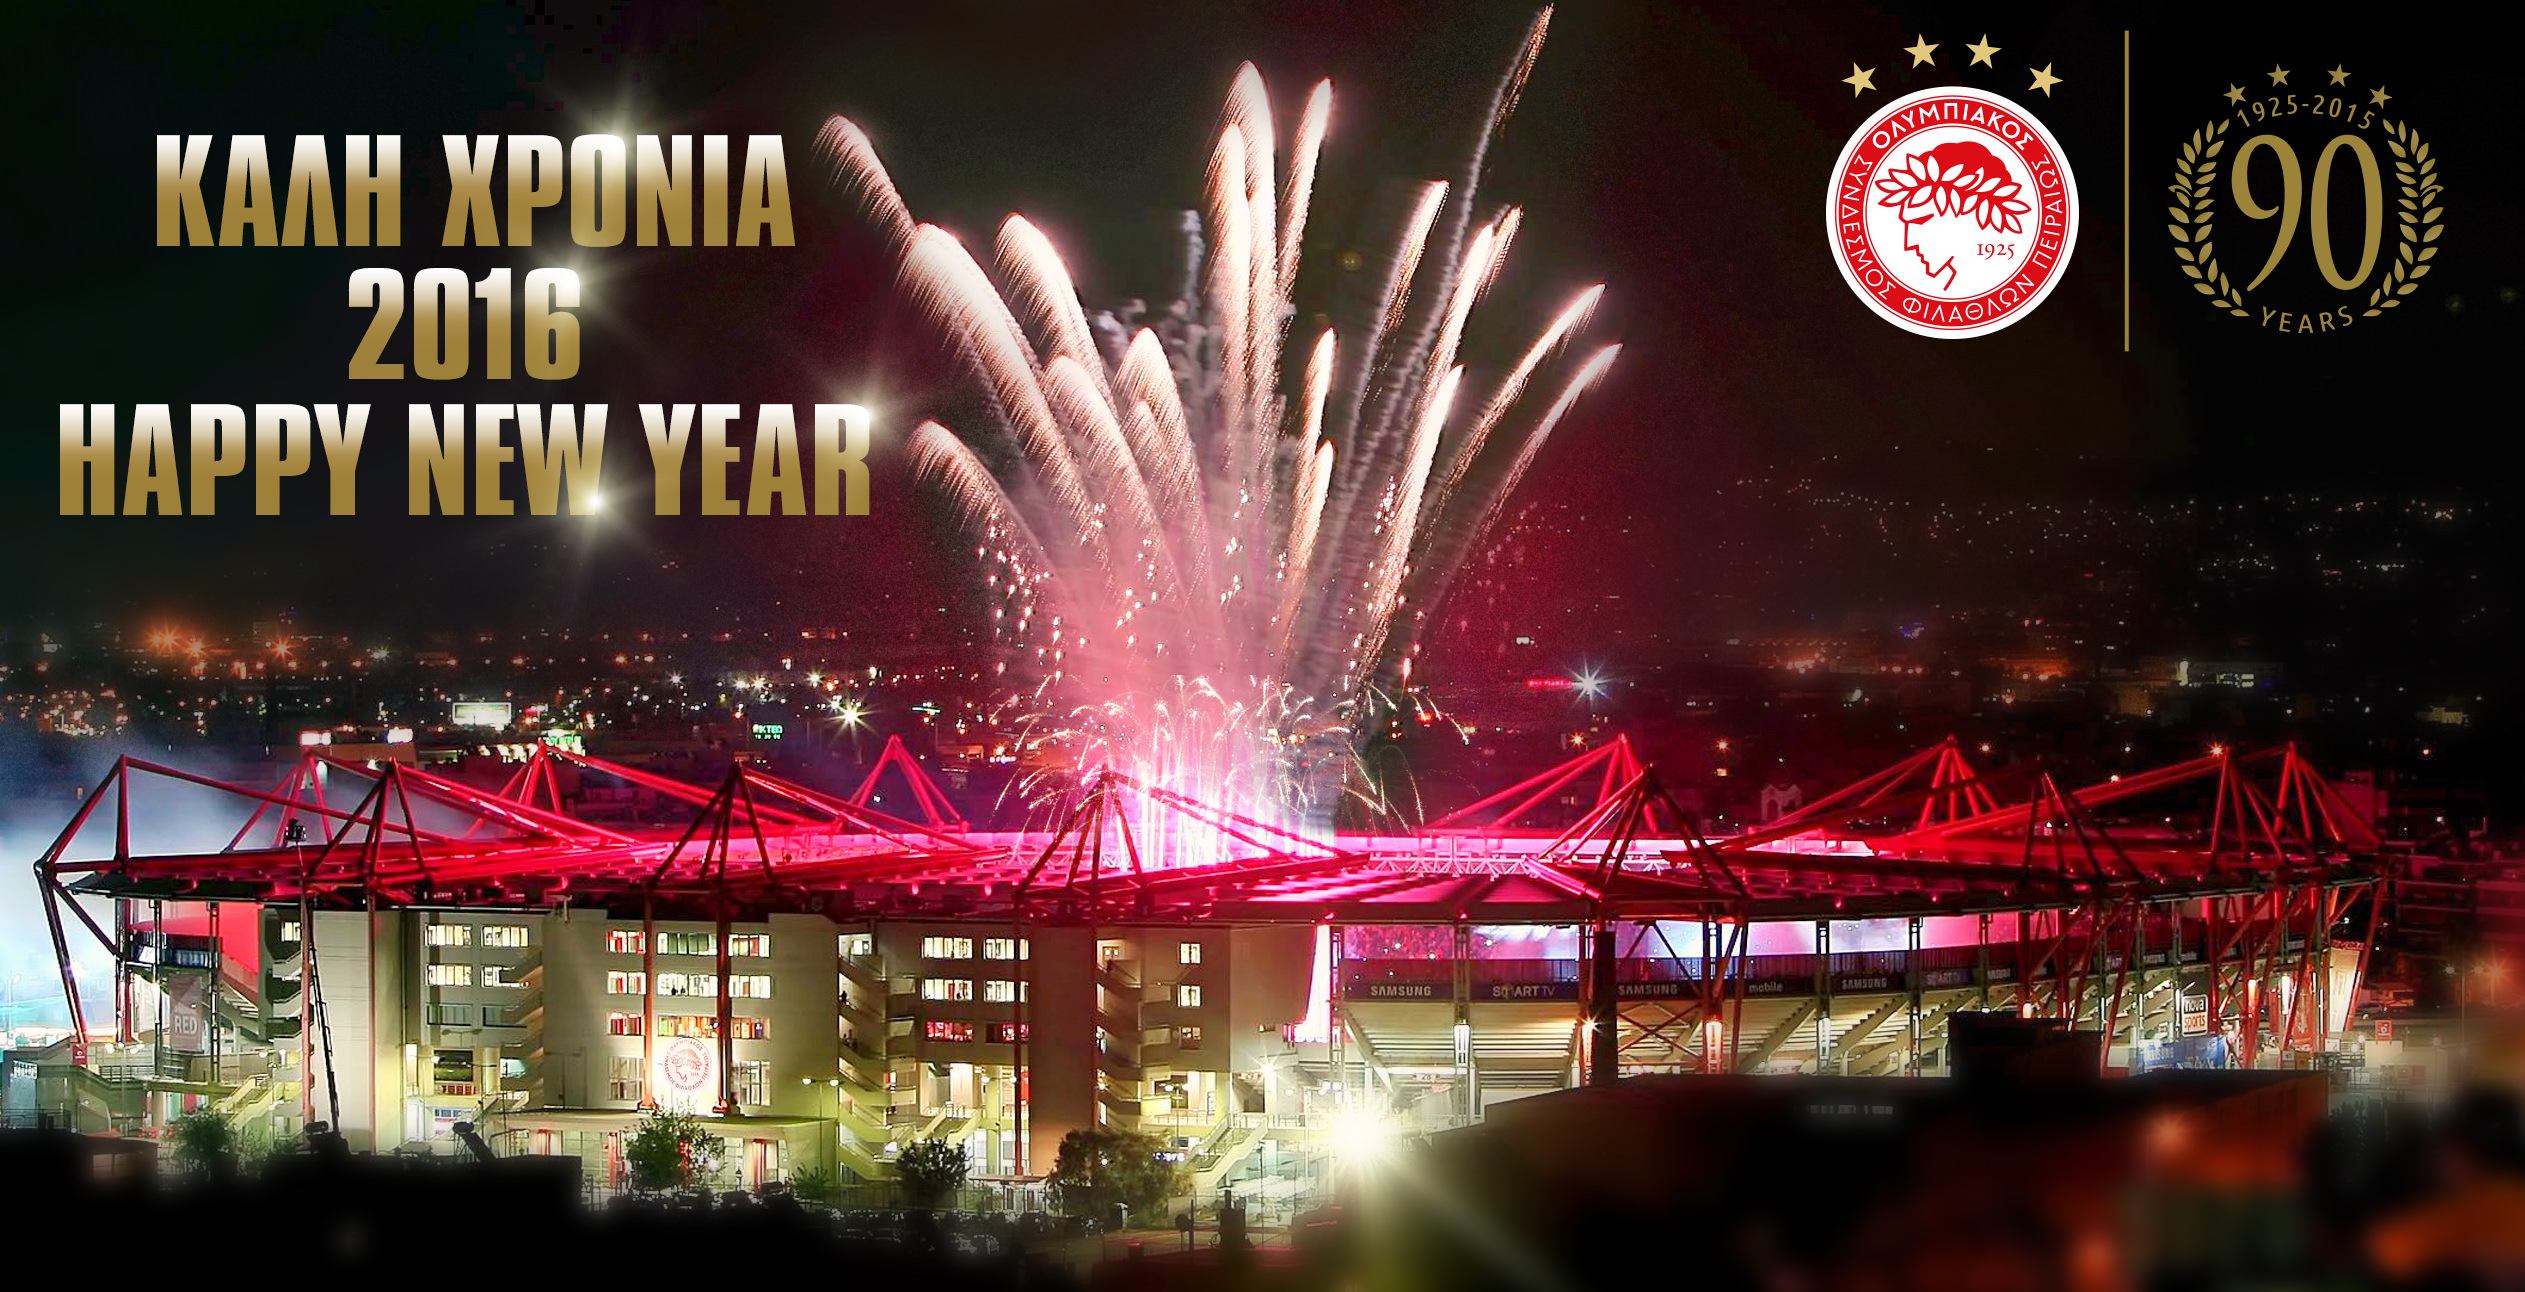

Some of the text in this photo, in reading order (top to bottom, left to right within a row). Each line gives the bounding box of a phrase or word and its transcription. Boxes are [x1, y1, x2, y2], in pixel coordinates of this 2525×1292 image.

[1370, 985, 1432, 997] SAMSUNG
[1618, 984, 1678, 996] SAMSUNG
[1749, 981, 1783, 993] mobile
[174, 1015, 198, 1035] RED
[2184, 1014, 2206, 1031] sports
